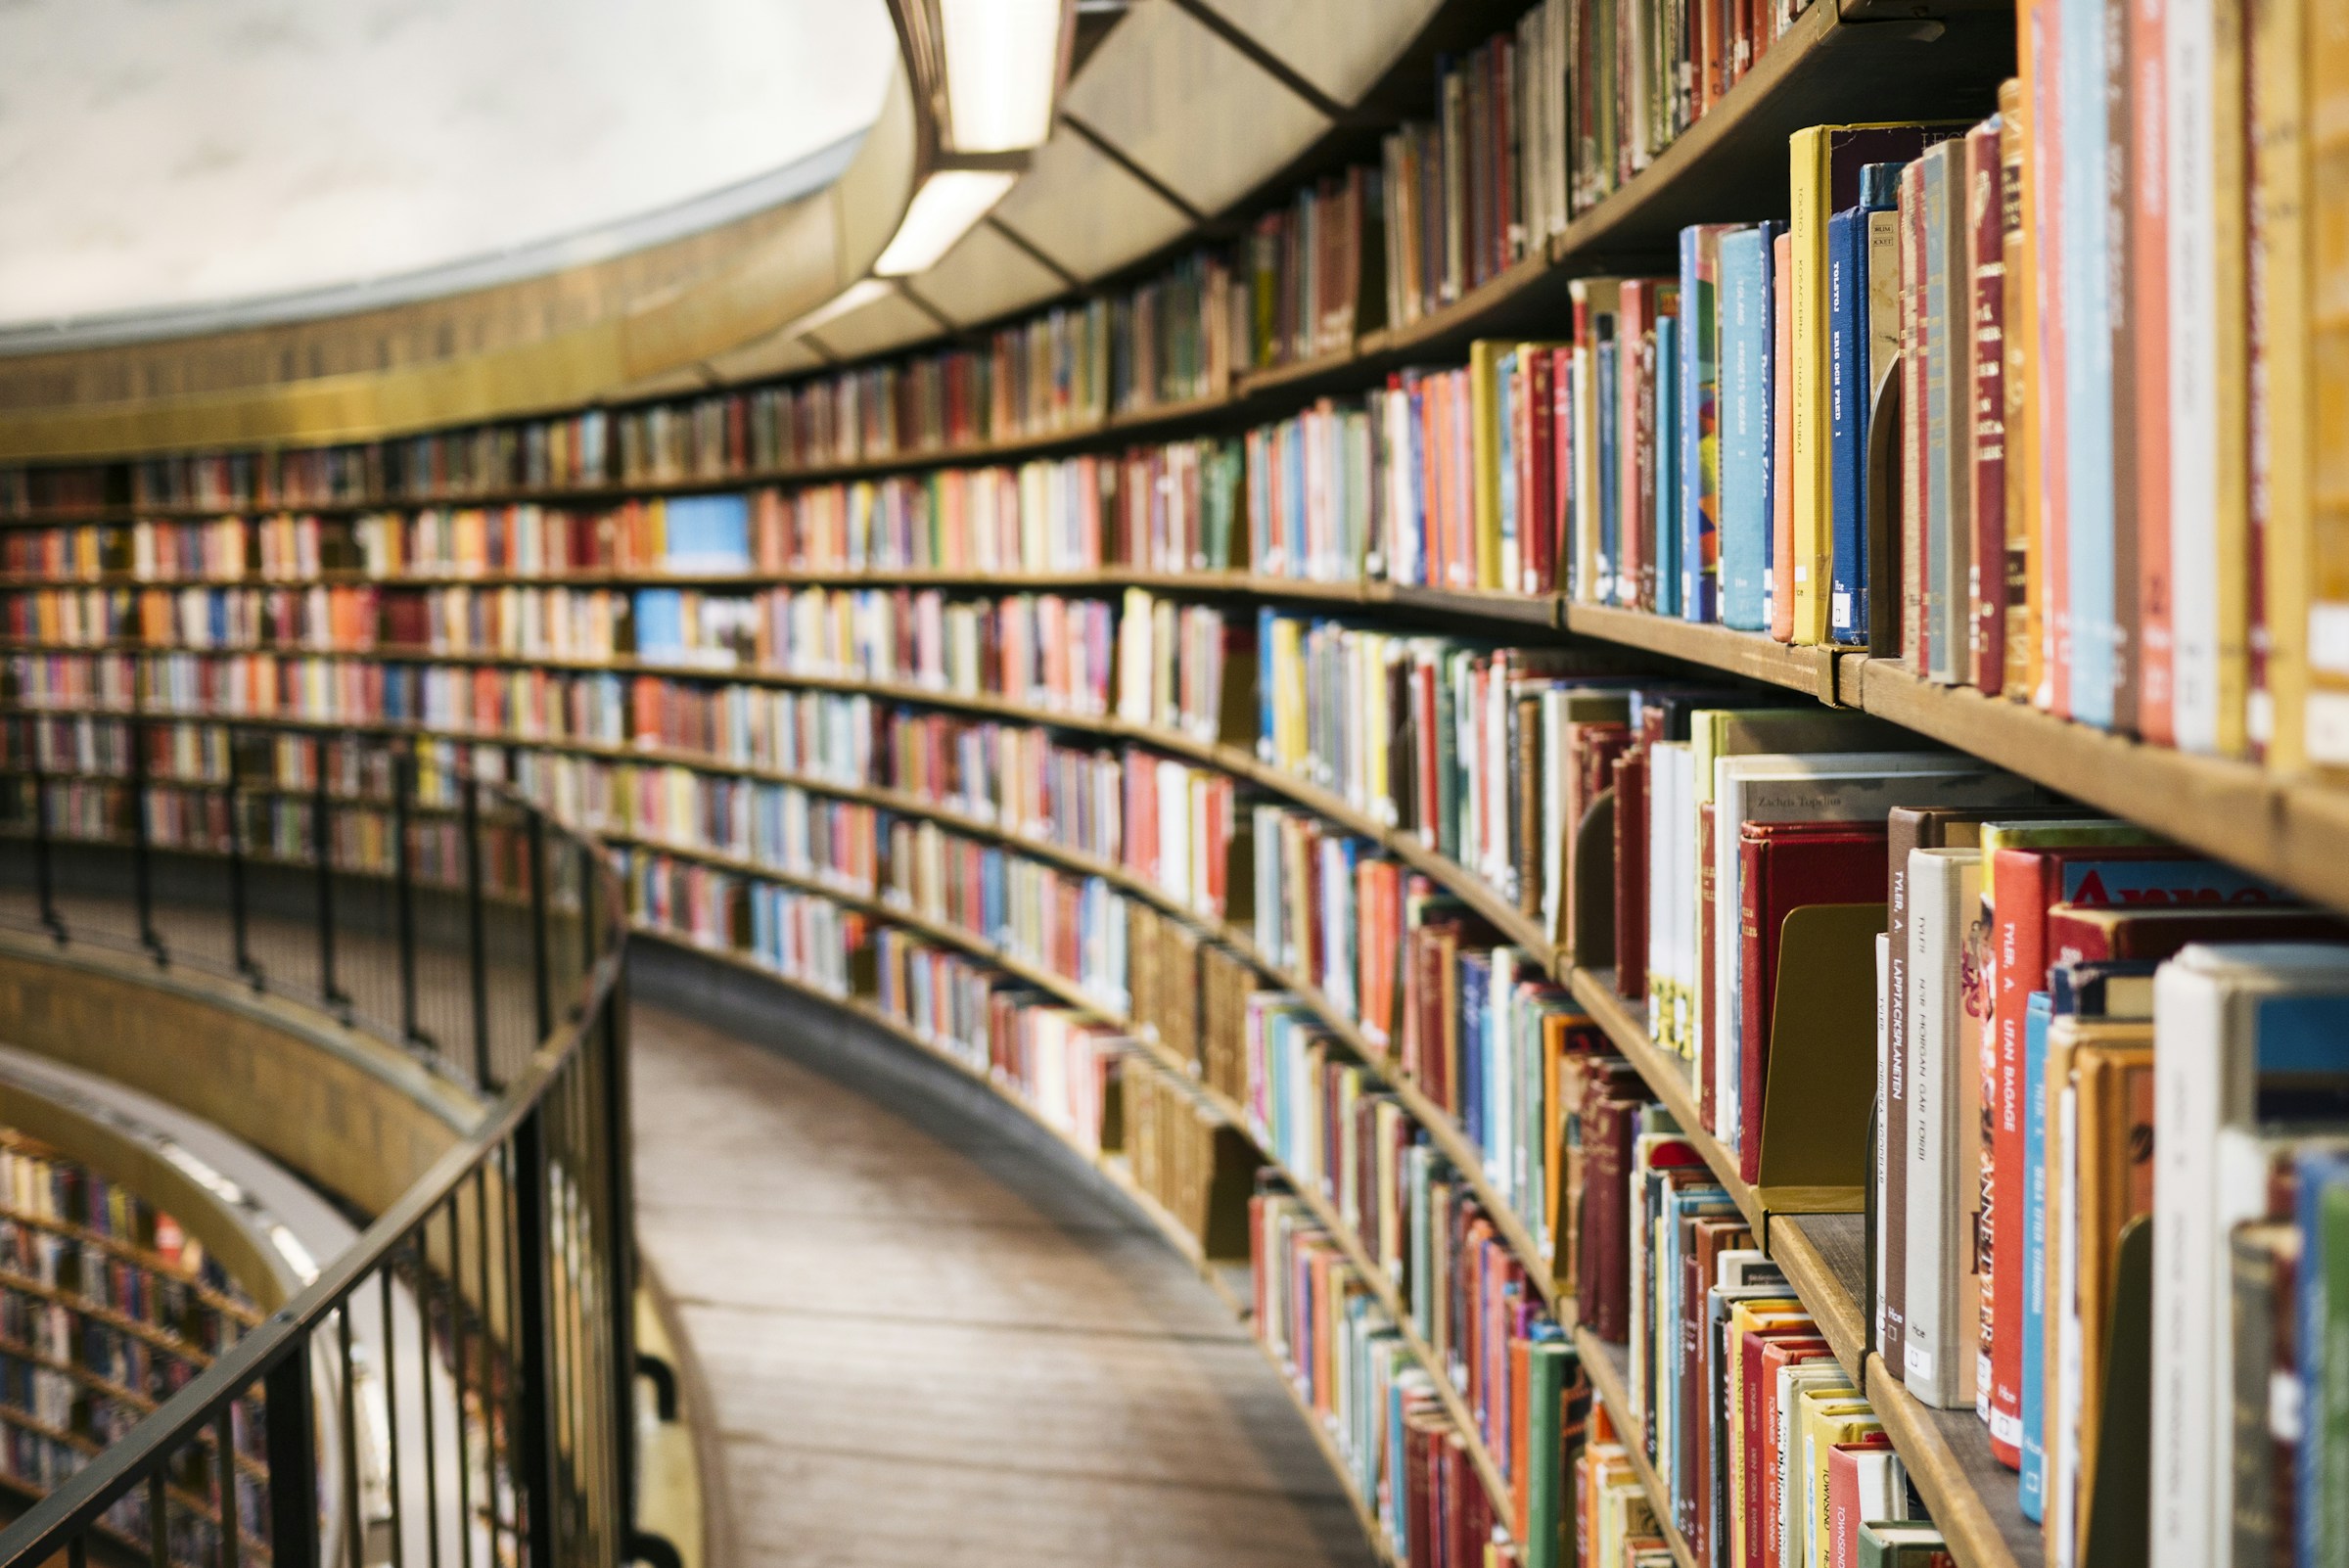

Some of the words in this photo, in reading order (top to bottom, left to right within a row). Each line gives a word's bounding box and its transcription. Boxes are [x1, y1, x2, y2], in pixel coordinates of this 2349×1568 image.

[1758, 795, 1795, 807] Zachris
[1799, 794, 1842, 809] Topelius
[1893, 871, 1904, 913] TYLER,
[1918, 916, 1927, 954] TYLER
[2003, 923, 2015, 970] TYLER,
[1917, 1013, 1927, 1078] MORGAN
[2003, 1019, 2015, 1061] UTAN
[2003, 1065, 2015, 1133] BAGAGE
[1979, 1153, 1995, 1245] ANNE
[1978, 1251, 1995, 1342] TYLER
[1837, 1505, 1846, 1568] TOWNSEND
